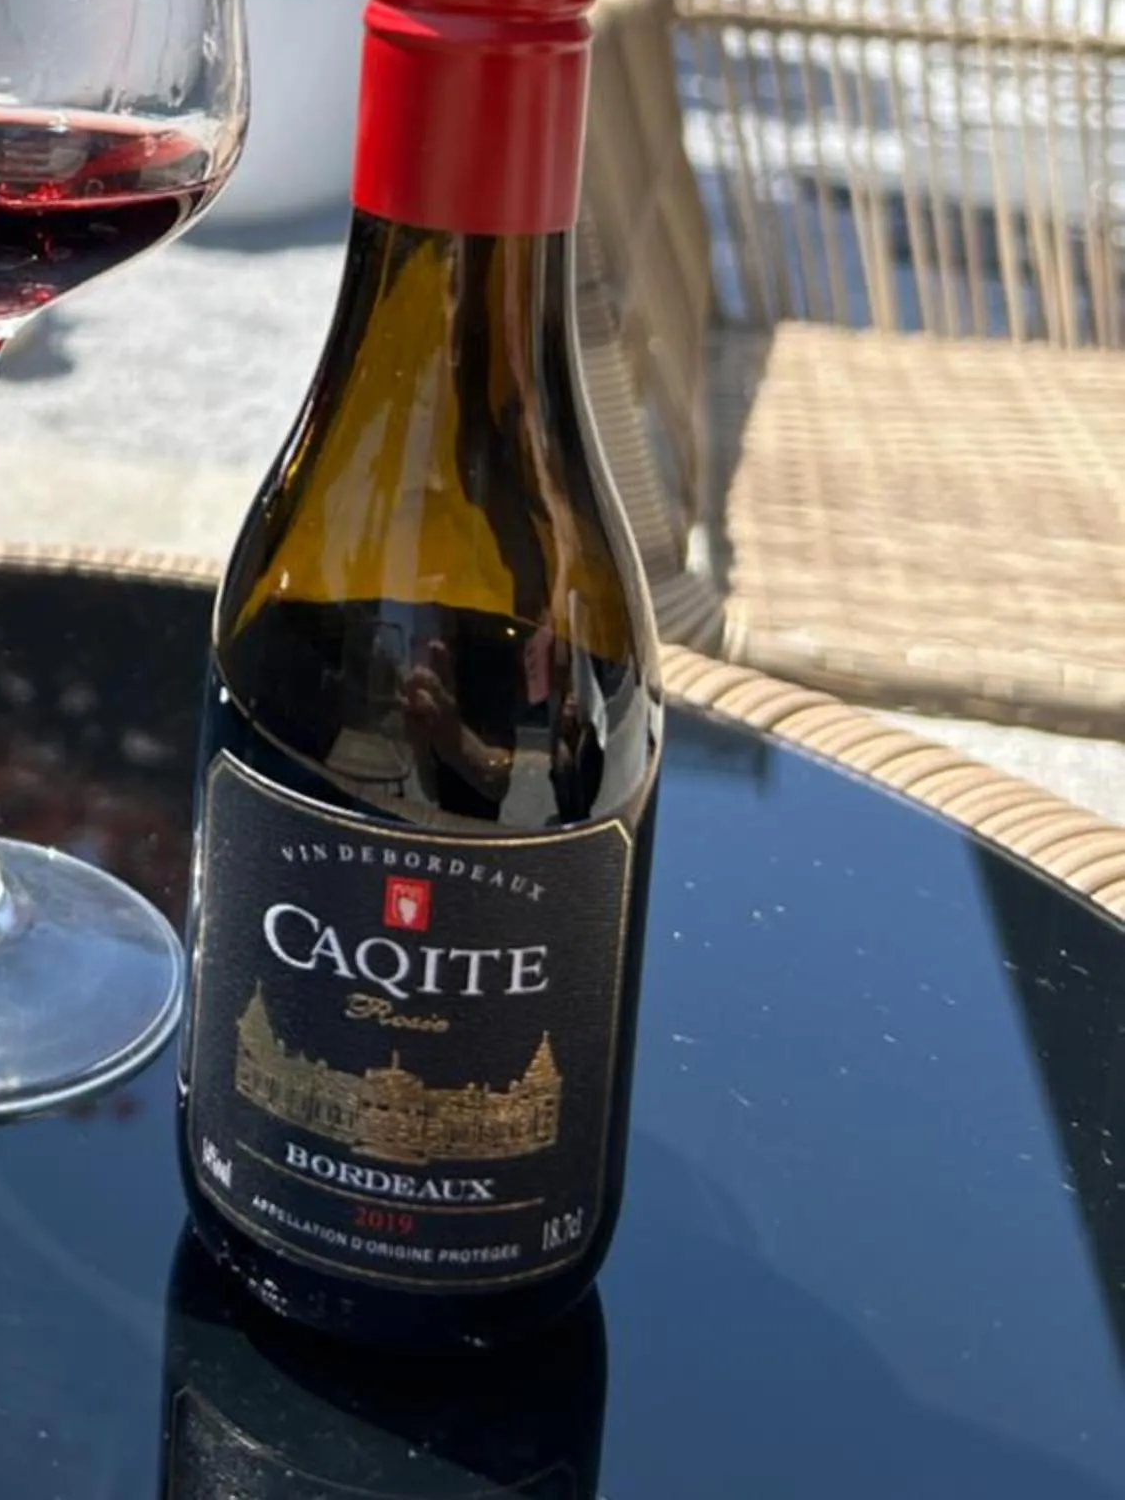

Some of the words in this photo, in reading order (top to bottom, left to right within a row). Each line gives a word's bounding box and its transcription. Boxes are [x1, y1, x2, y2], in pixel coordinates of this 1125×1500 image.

[281, 844, 328, 862] VIN
[263, 902, 550, 999] CAQITE
[285, 1142, 495, 1200] BORDEAUX
[252, 1194, 348, 1246] APPELLATION
[354, 1205, 414, 1235] 2019
